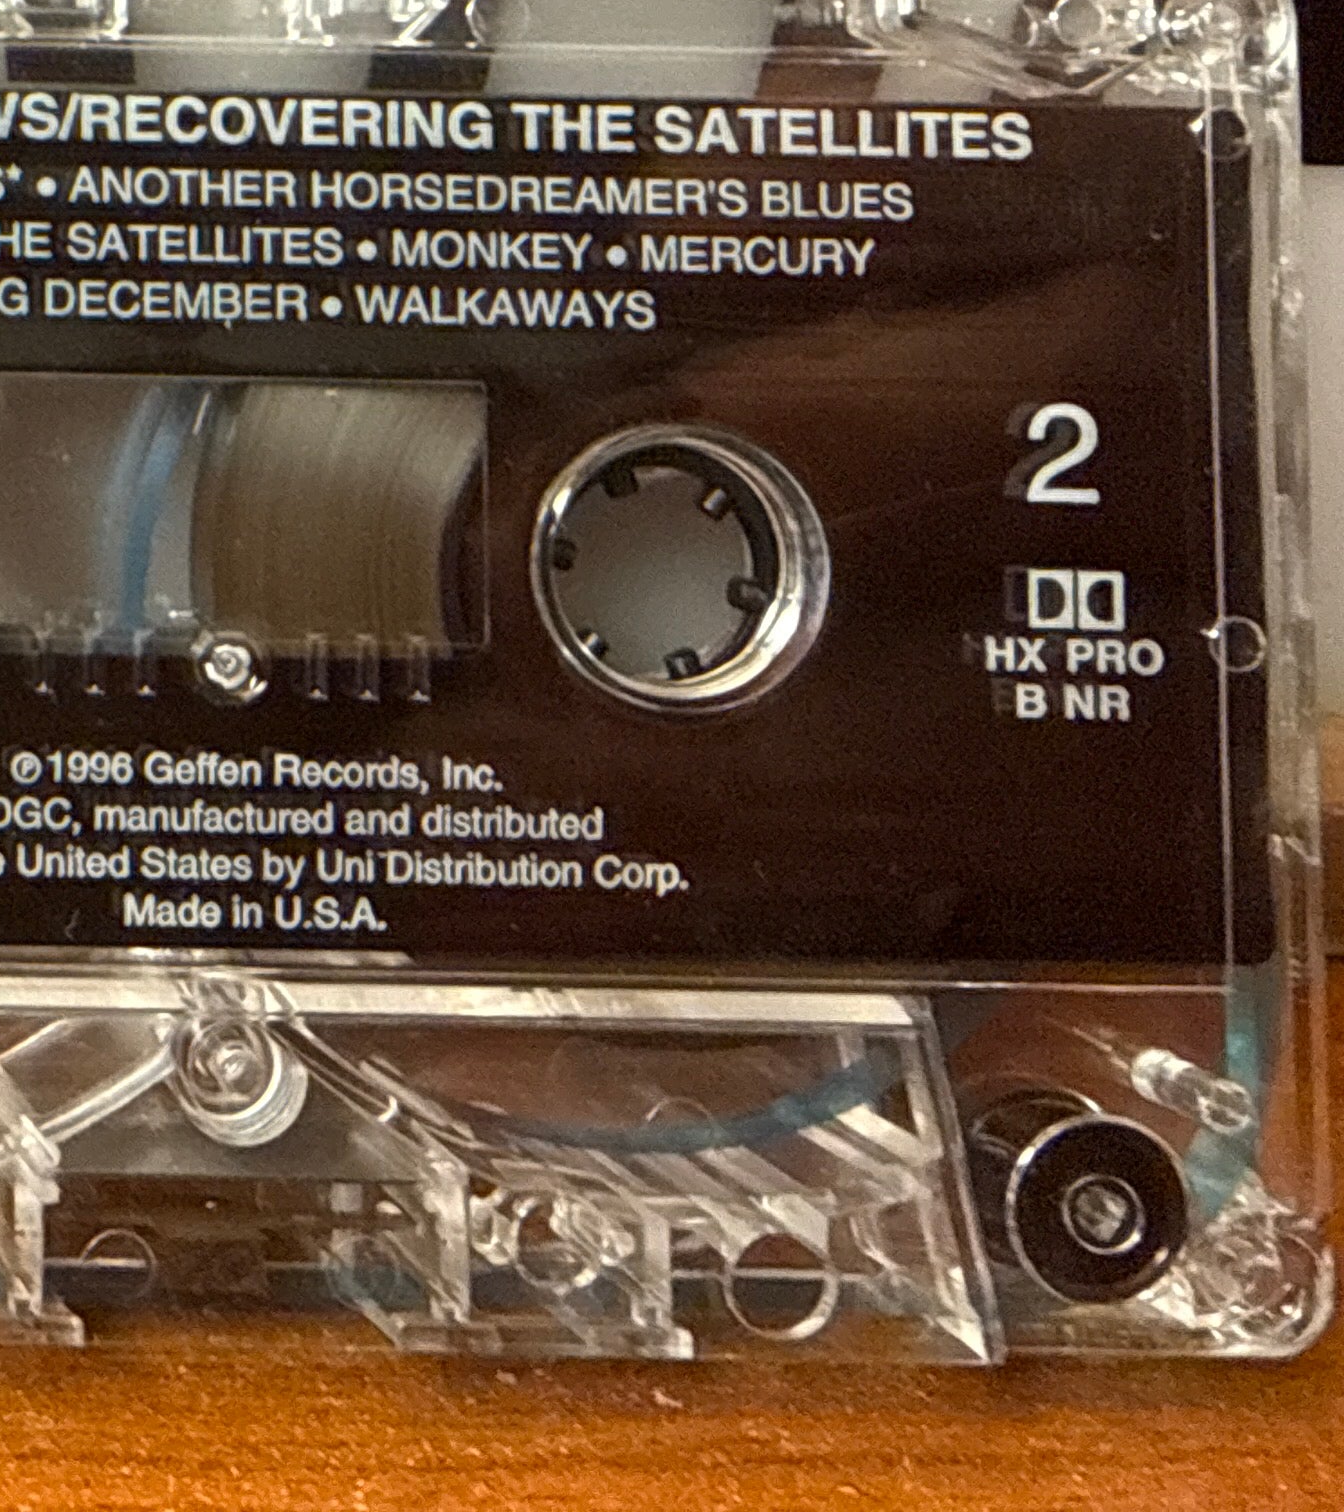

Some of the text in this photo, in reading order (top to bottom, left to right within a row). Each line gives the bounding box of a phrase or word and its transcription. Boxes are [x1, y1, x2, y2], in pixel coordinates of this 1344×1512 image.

[510, 102, 636, 152] THE
[653, 104, 1034, 161] SATELLITES
[68, 165, 297, 207] ANOTHER
[311, 170, 748, 218] HORSEDREAMER'S
[761, 180, 914, 221] BLUES
[67, 221, 344, 266] SATELLITES
[392, 229, 592, 271] MONKEY
[641, 234, 875, 276] MERCURY
[44, 278, 308, 322] DECEMBER
[355, 285, 656, 330] WALKAWAYS
[1026, 403, 1100, 504] 2
[984, 635, 1165, 676] HX PRO
[1015, 683, 1130, 721] B NR
[143, 750, 262, 786] Geffen
[273, 752, 430, 795] Records,
[442, 756, 503, 792] Inc.
[93, 798, 334, 835] manufactured
[344, 803, 411, 837] and
[421, 804, 604, 841] distributed
[16, 843, 131, 879] United
[140, 846, 253, 881] States
[262, 847, 306, 890] by
[316, 848, 375, 883] Uni
[385, 850, 583, 888] Distribution
[593, 854, 689, 897] Corp.
[123, 892, 387, 931] Made in U.S.A.
